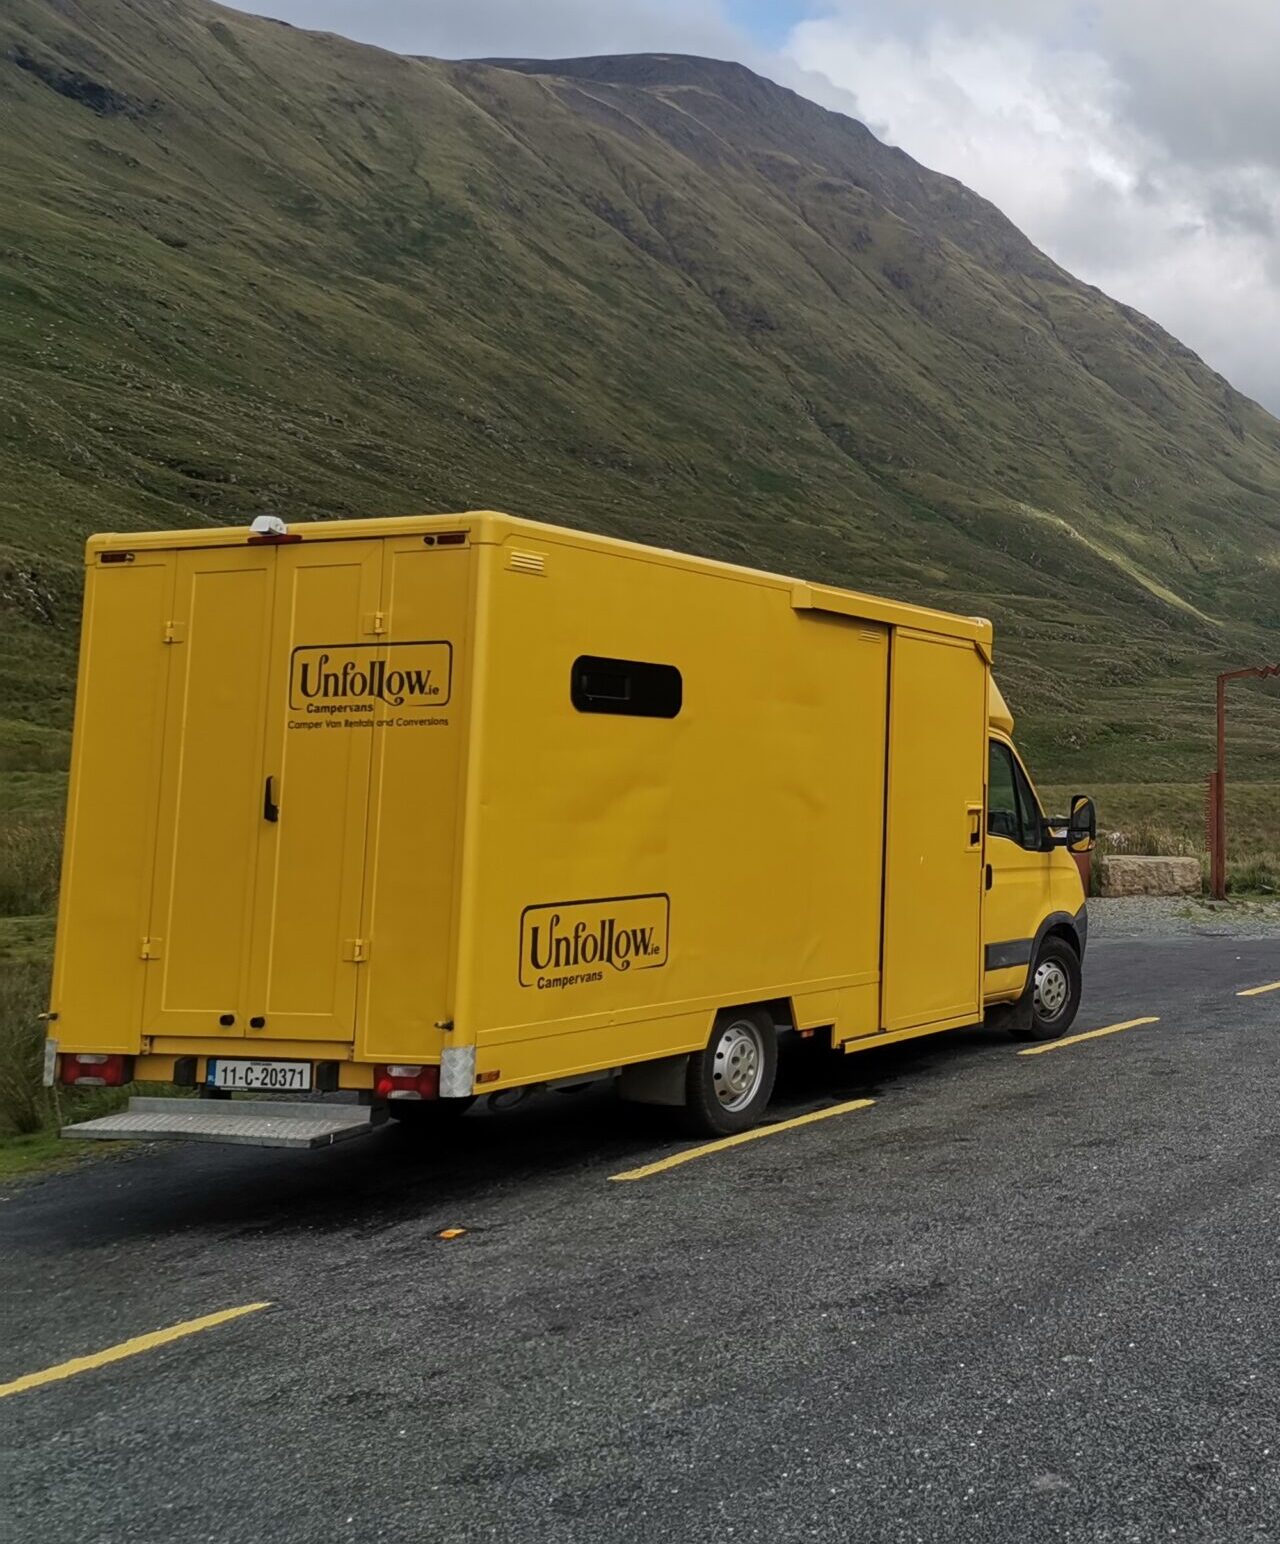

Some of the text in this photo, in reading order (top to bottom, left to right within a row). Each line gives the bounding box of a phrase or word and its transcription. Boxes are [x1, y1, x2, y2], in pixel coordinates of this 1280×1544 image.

[300, 654, 440, 707] Unfollow.ie
[287, 716, 449, 731] Camper Van Rentals and Conversions
[531, 914, 660, 971] Unfollow.ie
[537, 970, 604, 990] Campervans
[221, 1066, 304, 1087] 11-C-20371
